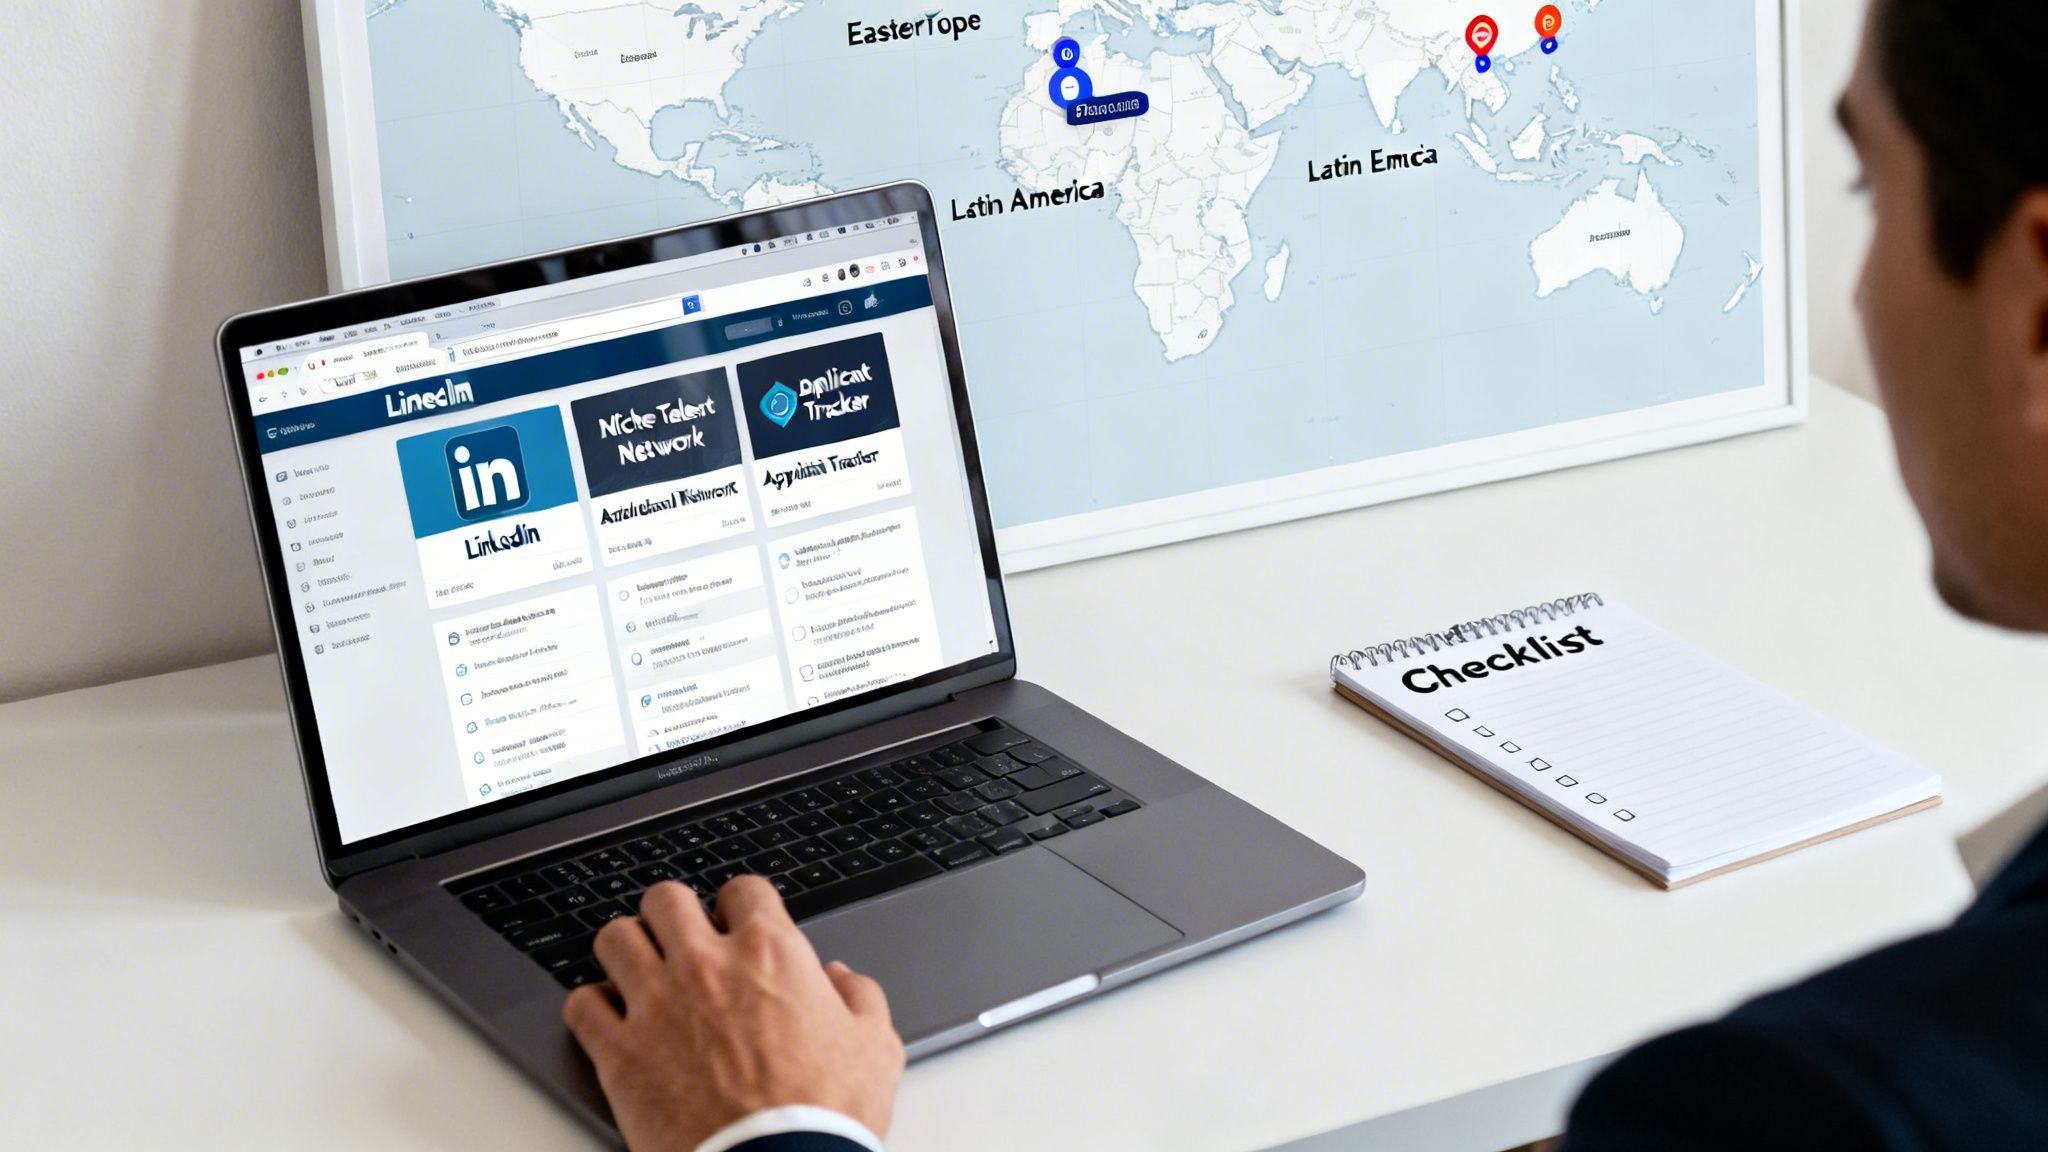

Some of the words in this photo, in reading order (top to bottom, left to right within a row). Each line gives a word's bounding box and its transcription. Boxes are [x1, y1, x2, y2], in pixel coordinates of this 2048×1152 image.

[1308, 154, 1362, 182] Latin
[951, 194, 1003, 221] Latin
[1010, 179, 1104, 212] America
[454, 445, 521, 511] in
[1401, 625, 1604, 694] Checklist
